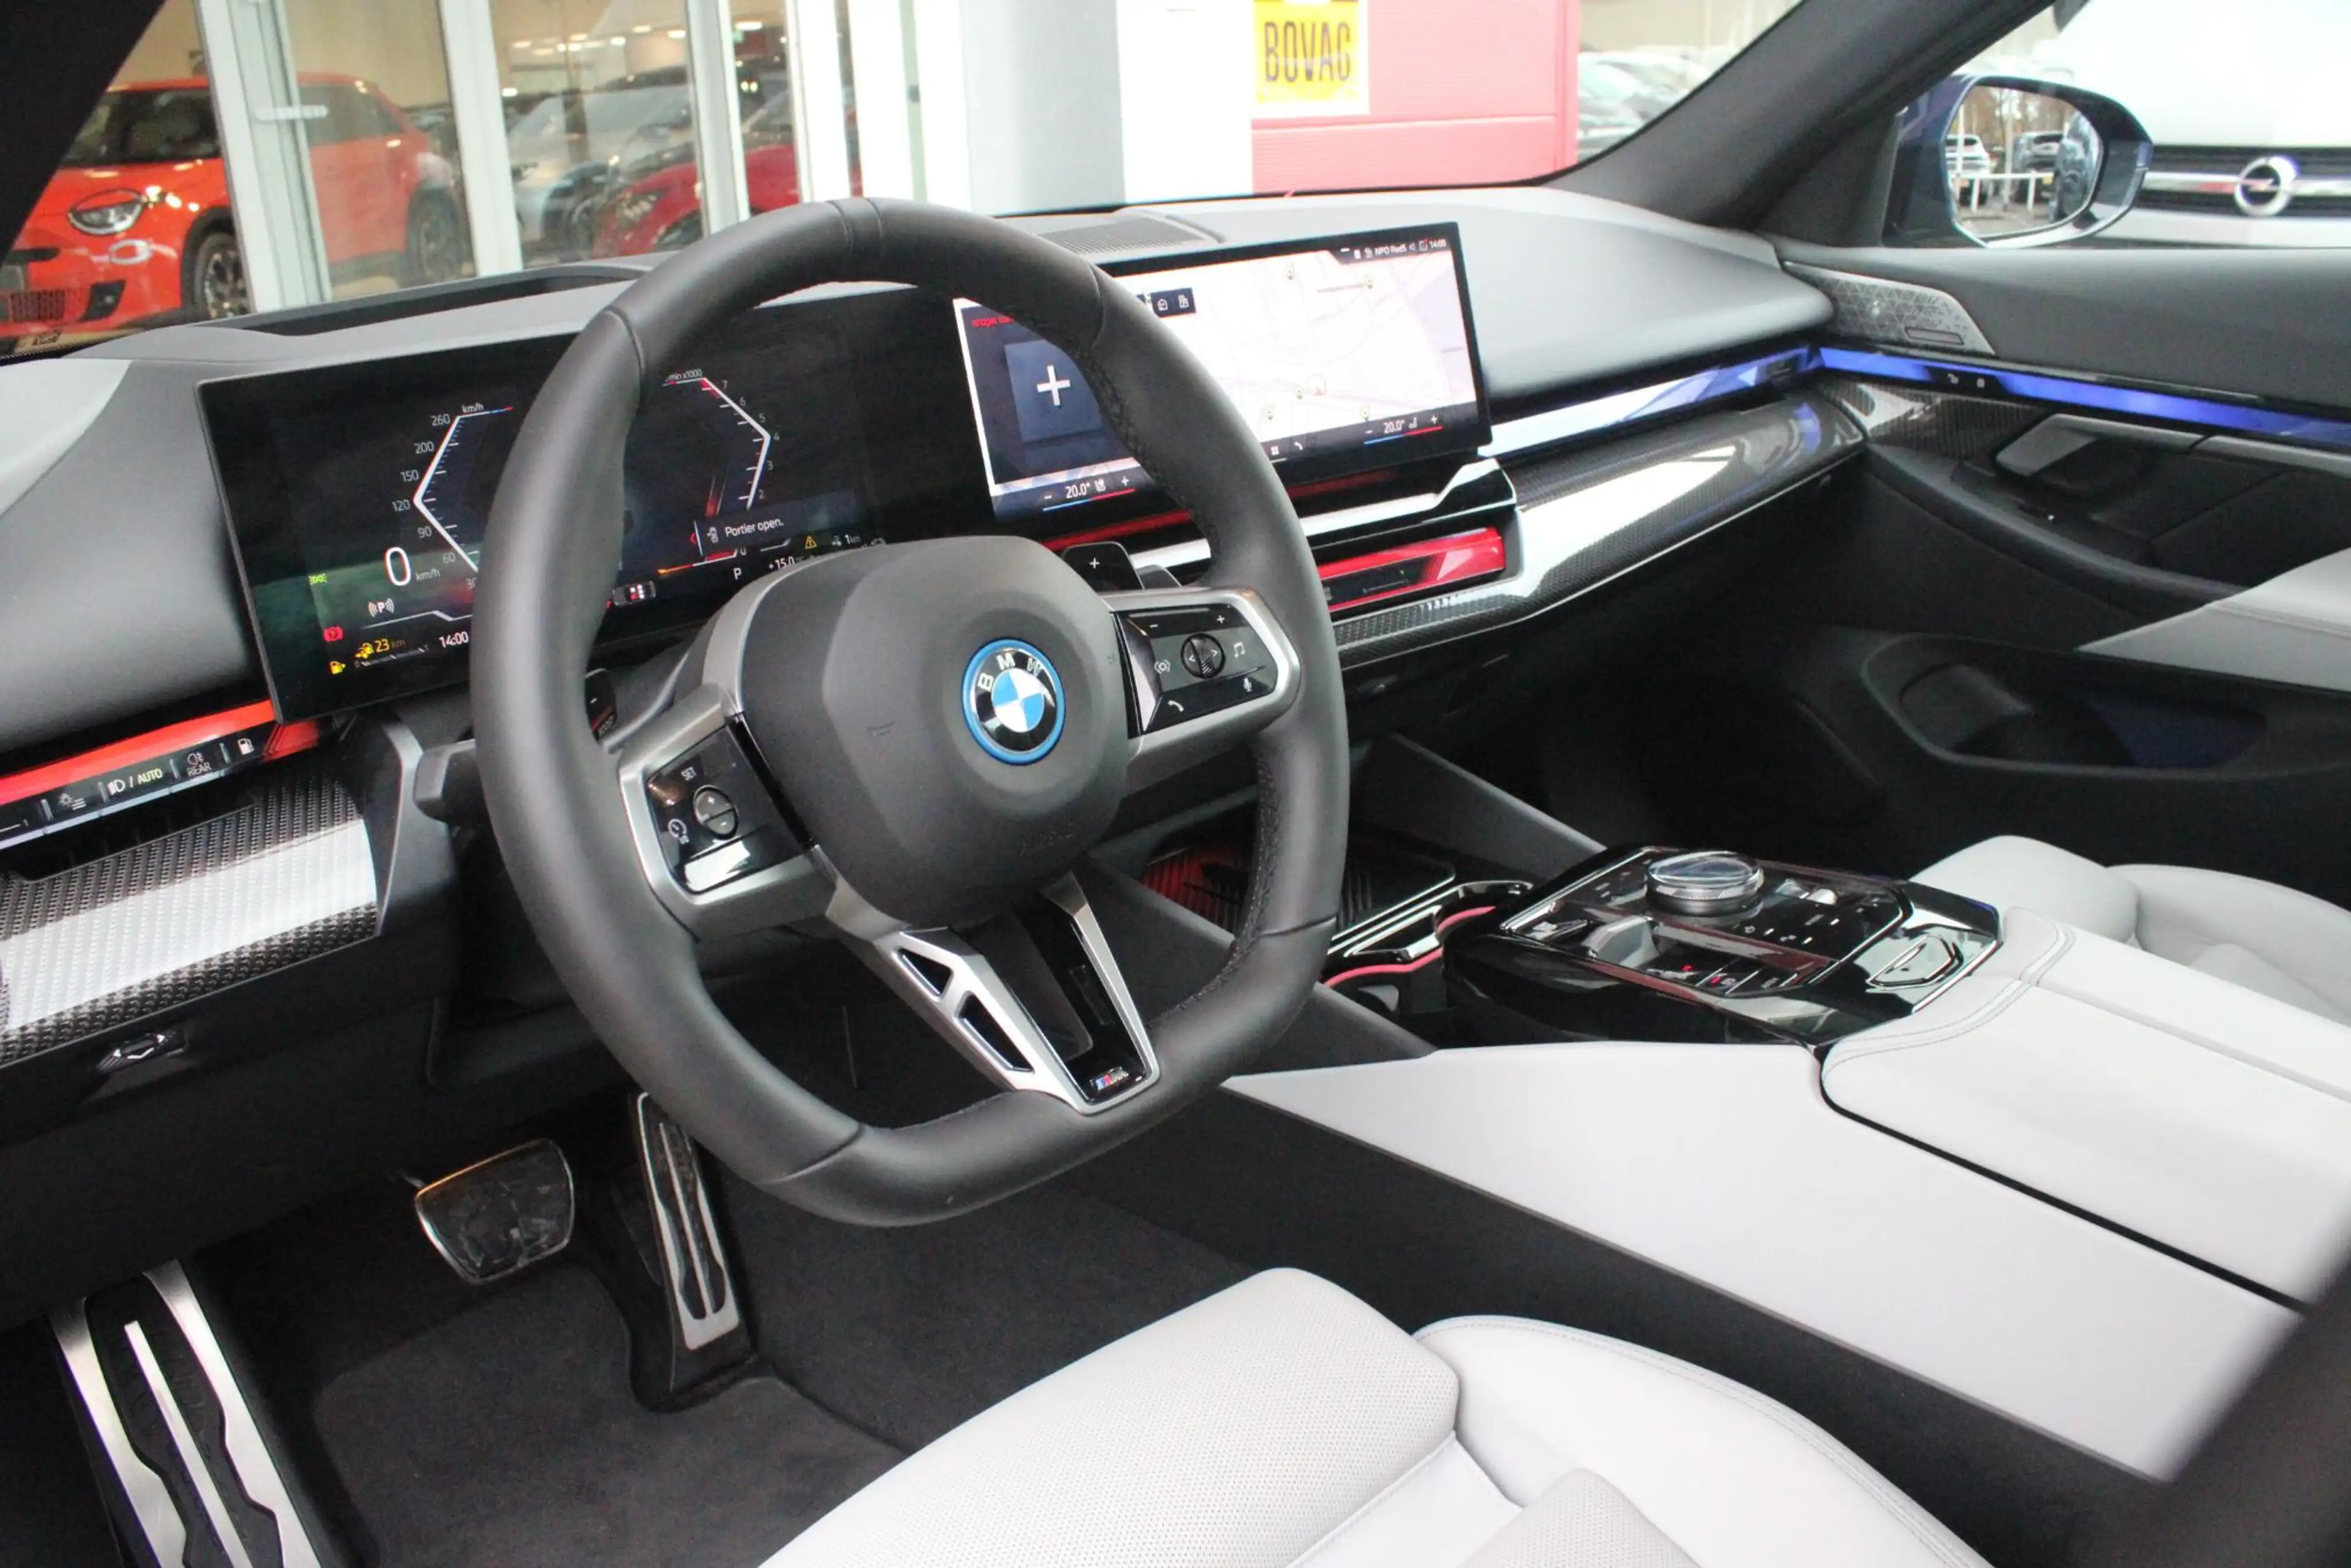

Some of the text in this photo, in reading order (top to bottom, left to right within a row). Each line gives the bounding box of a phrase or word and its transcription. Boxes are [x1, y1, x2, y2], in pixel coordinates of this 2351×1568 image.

[461, 403, 484, 413] km/h
[431, 414, 451, 427] 260
[414, 441, 434, 454] 200
[400, 469, 419, 482] 150
[391, 499, 411, 512] 120
[418, 525, 432, 538] 90
[725, 518, 784, 538] Portier open.
[384, 546, 411, 586] 0
[415, 568, 441, 581] km/h
[733, 568, 742, 580] P
[374, 638, 390, 653] 23
[438, 631, 469, 648] 14:00
[977, 651, 1041, 692] BMW
[187, 762, 212, 776] REAR
[137, 768, 163, 785] AUTO
